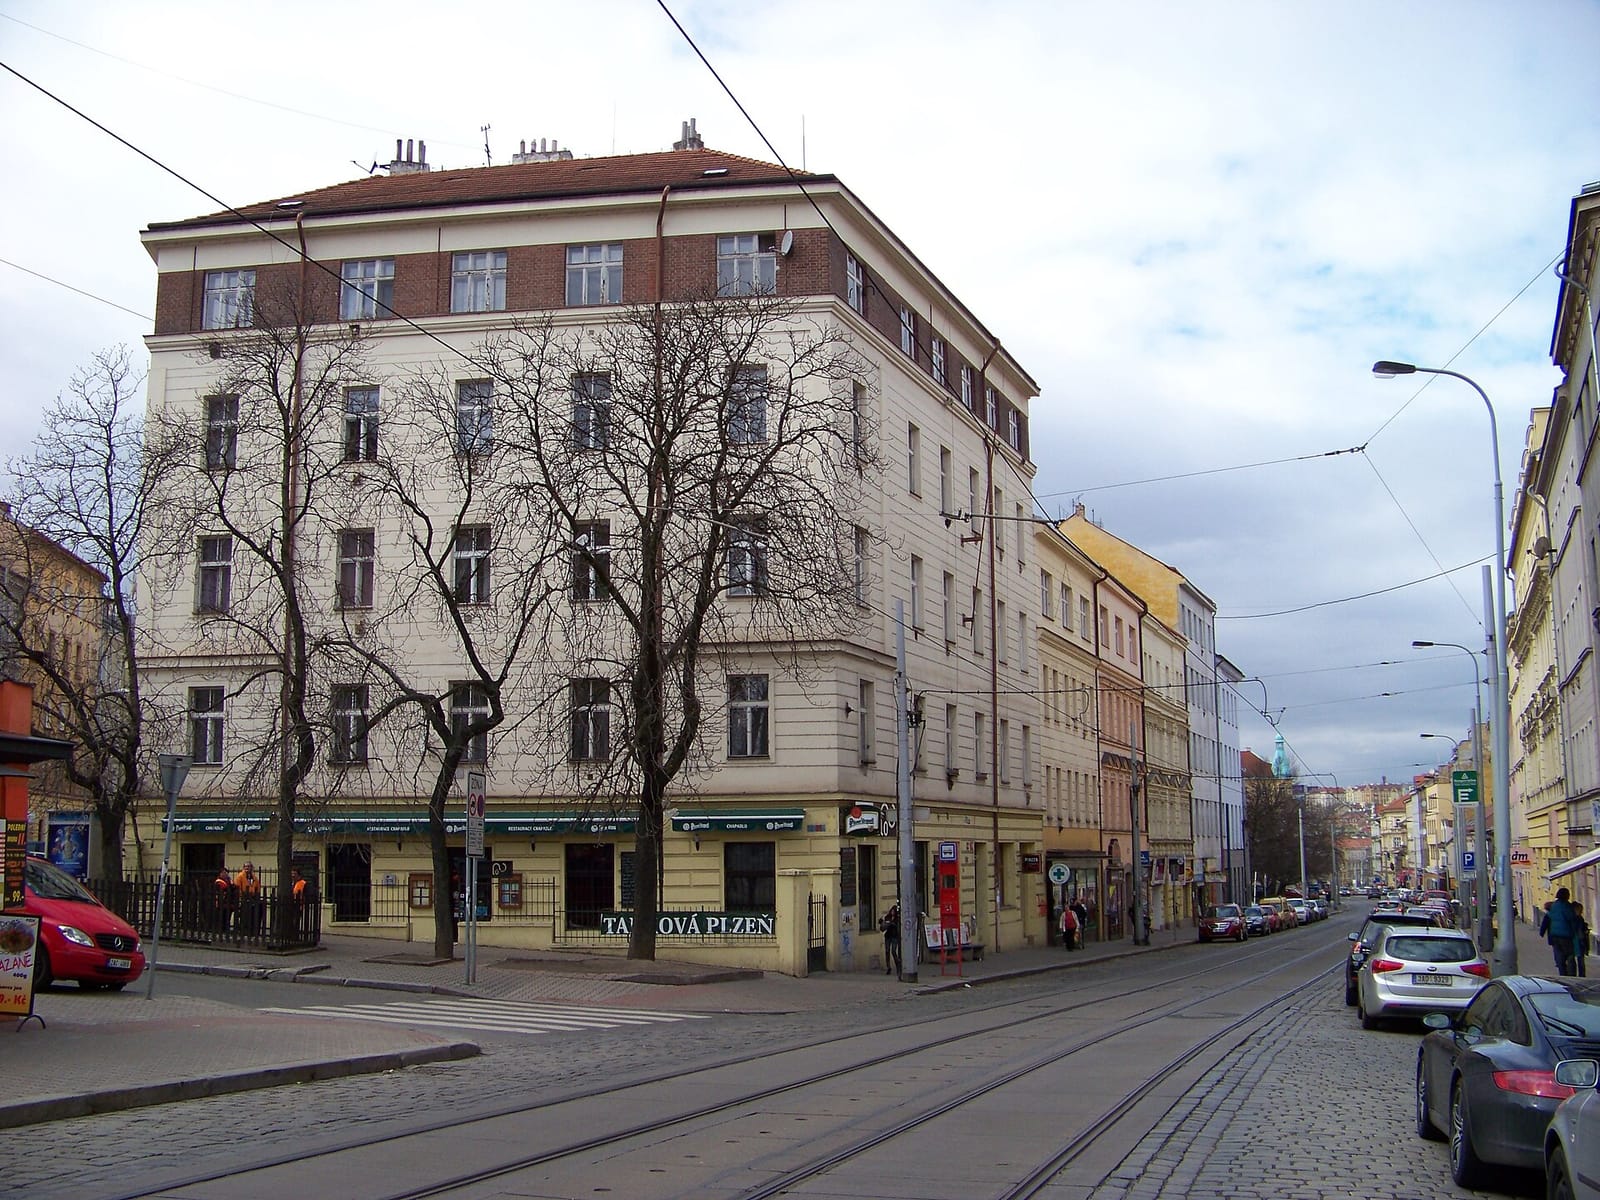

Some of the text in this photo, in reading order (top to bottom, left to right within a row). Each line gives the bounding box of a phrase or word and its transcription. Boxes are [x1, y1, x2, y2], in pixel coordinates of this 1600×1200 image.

[1464, 853, 1473, 865] P
[1511, 851, 1528, 861] dm
[603, 913, 774, 935] TAOVÁ PLZEŇ
